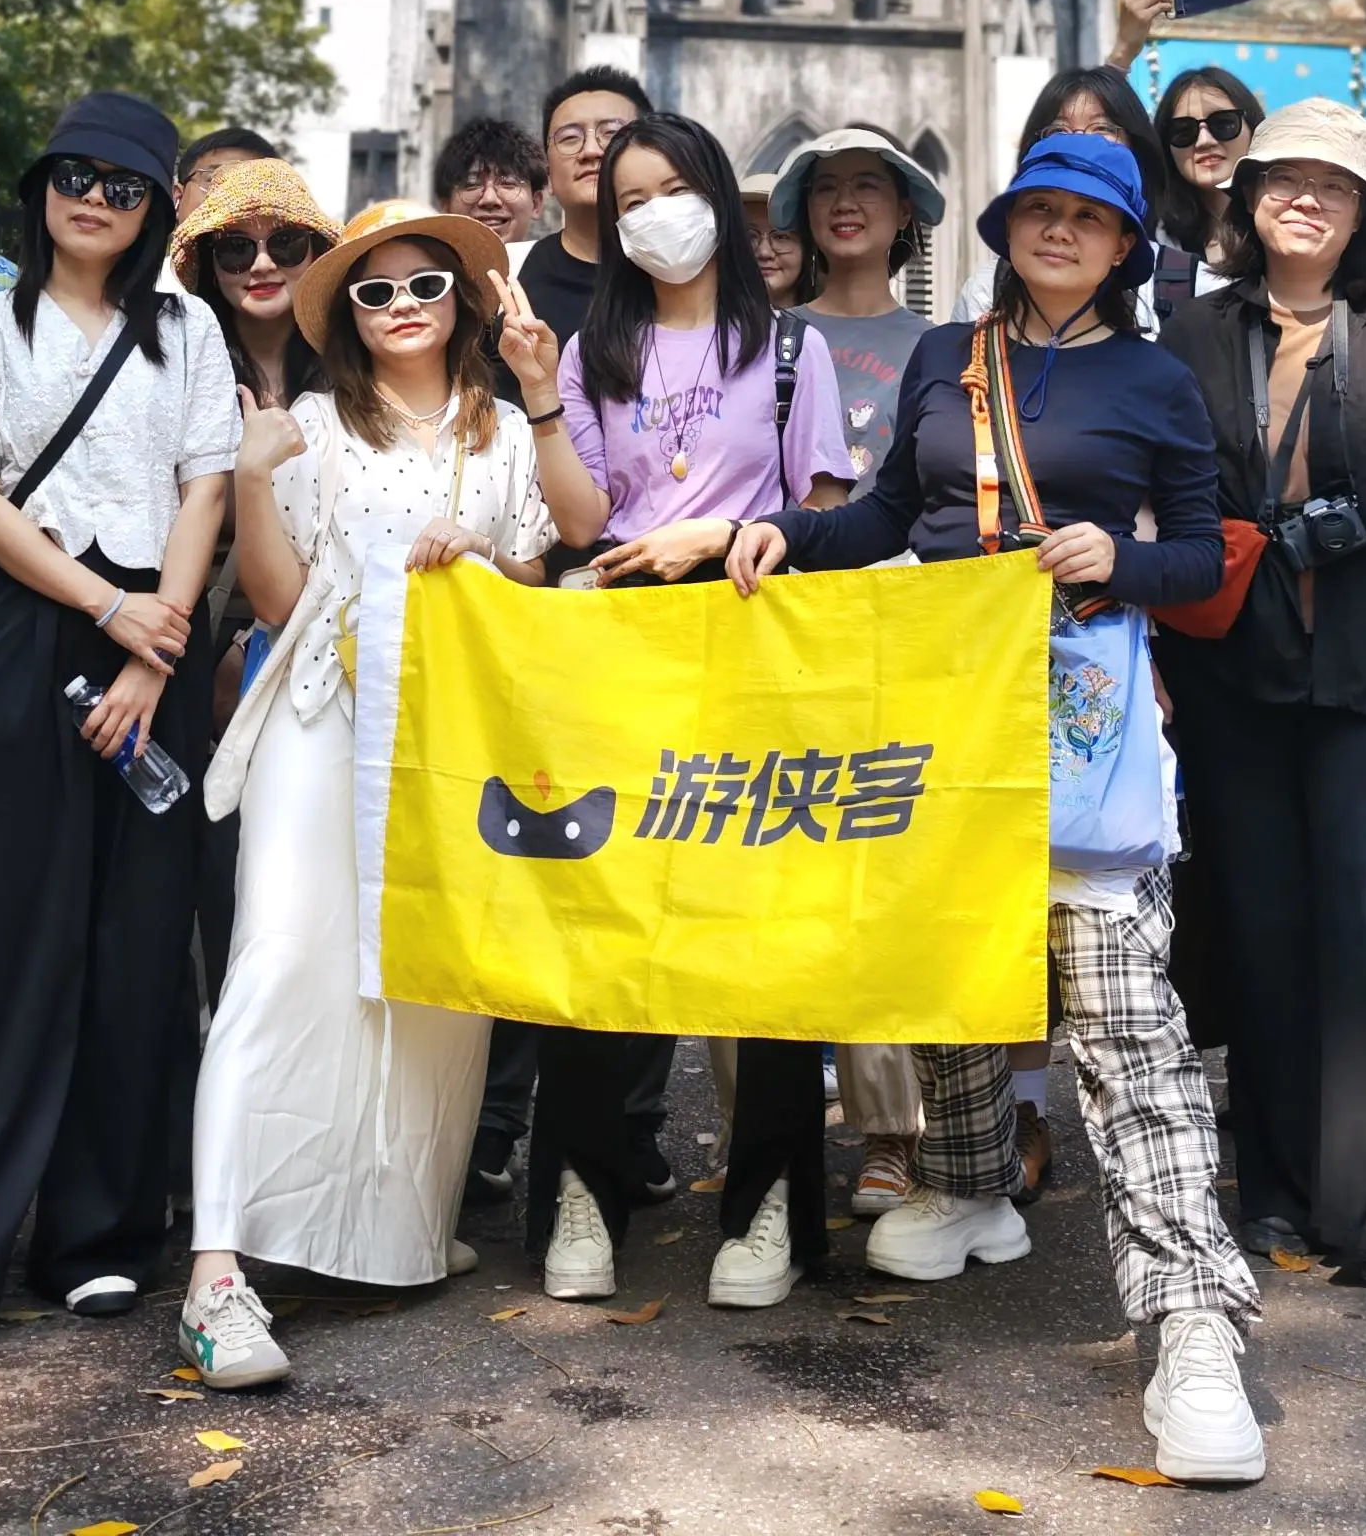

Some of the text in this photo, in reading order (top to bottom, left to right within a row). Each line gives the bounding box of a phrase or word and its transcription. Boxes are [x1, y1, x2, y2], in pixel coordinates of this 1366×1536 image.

[631, 386, 724, 434] KUROMI
[632, 741, 934, 847] 游侠客
